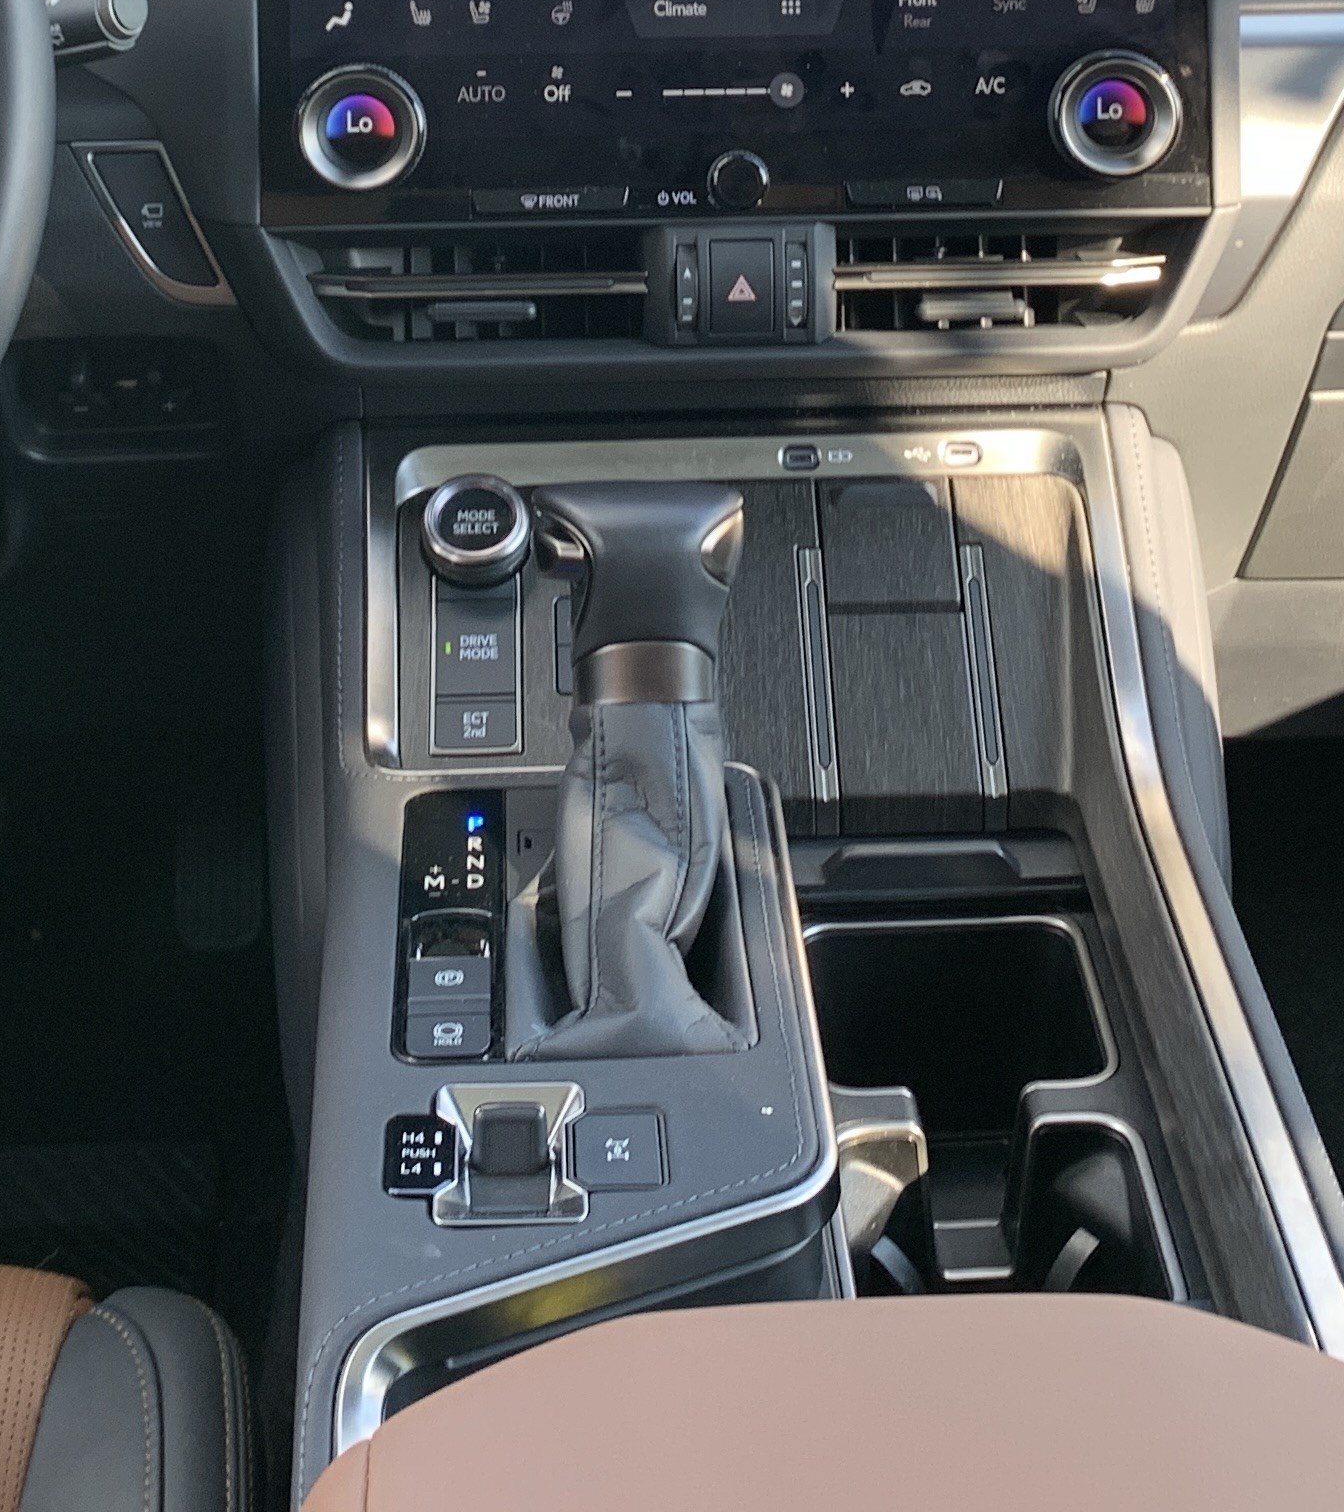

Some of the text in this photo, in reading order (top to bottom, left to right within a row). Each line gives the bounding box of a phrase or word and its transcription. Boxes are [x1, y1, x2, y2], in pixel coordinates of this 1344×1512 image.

[653, 0, 708, 17] Climate
[904, 14, 932, 29] Rear
[975, 77, 1006, 95] A/C
[457, 85, 571, 103] AUTO Off
[1096, 97, 1123, 121] Lo
[346, 109, 374, 134] Lo
[538, 194, 580, 209] FRONT
[672, 191, 697, 205] VOL
[457, 509, 496, 522] MODE
[453, 522, 499, 535] SELECT
[459, 634, 498, 648] DRIVE
[459, 647, 499, 661] MODE
[462, 711, 489, 725] ECT
[463, 725, 486, 738] 2nd
[467, 816, 484, 833] P
[467, 835, 483, 853] R
[466, 854, 485, 871] N
[423, 874, 445, 891] M
[466, 873, 485, 890] D
[402, 1131, 425, 1145] H4
[401, 1147, 436, 1159] PUSH
[400, 1162, 422, 1176] L4
